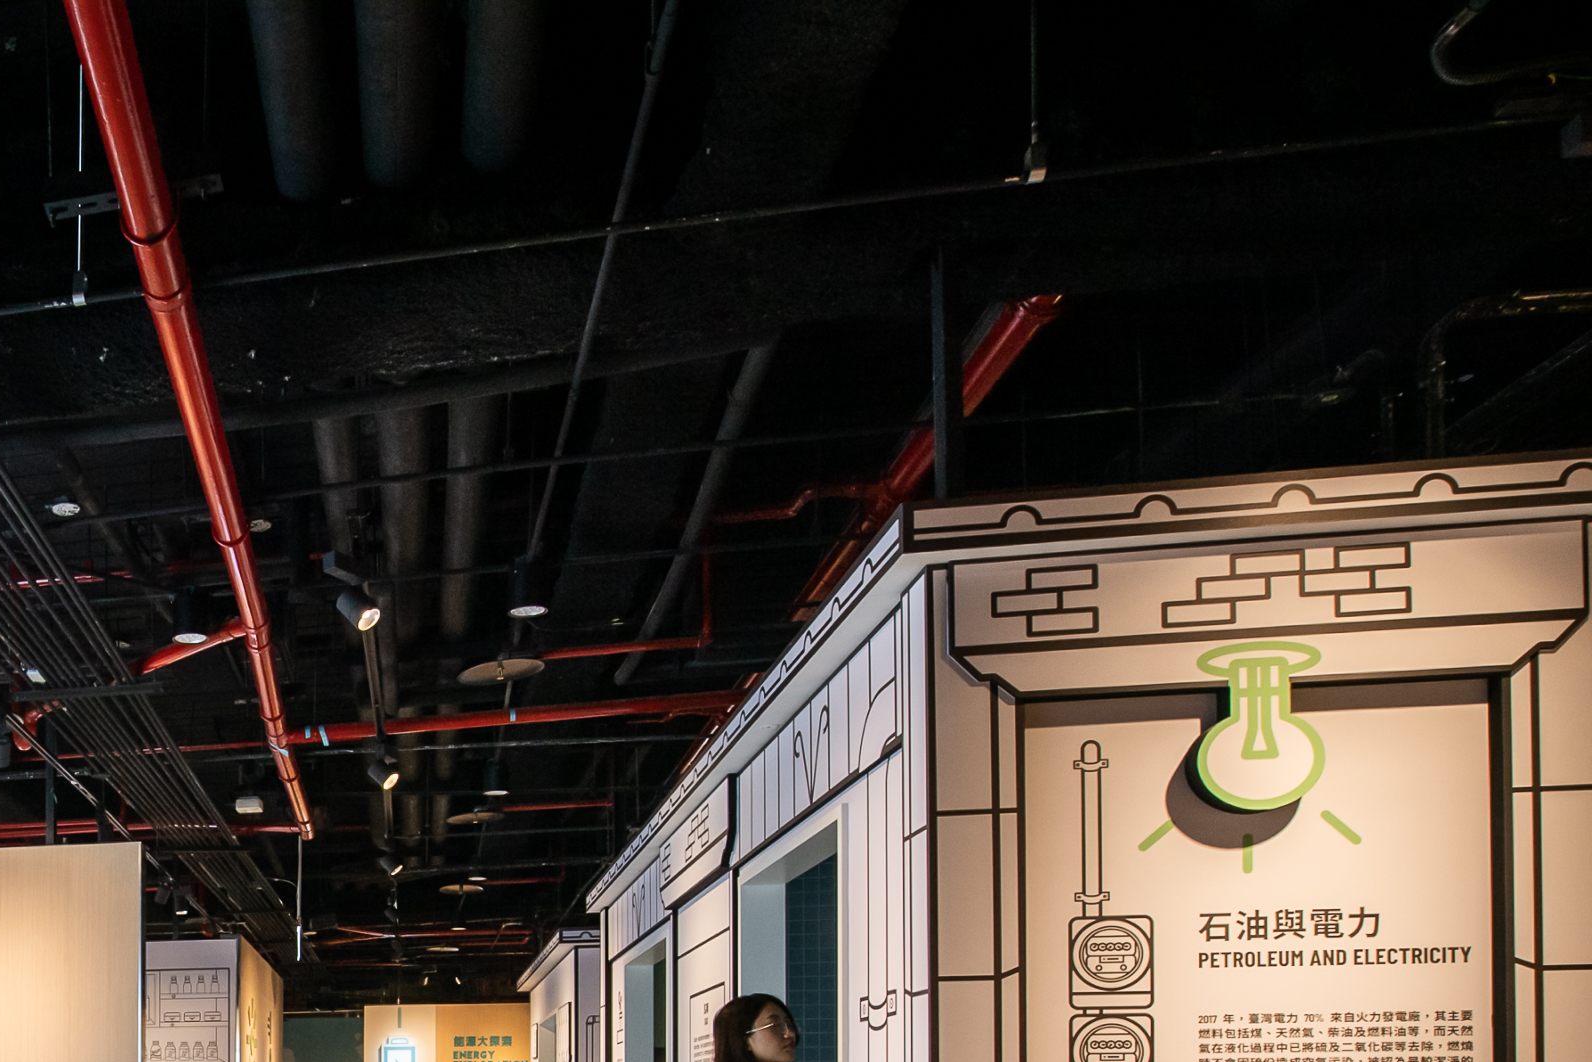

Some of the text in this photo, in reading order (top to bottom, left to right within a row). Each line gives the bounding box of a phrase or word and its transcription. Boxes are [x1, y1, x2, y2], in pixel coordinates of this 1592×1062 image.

[1199, 906, 1381, 943] 石油與電力
[1198, 946, 1472, 970] PETROLEUM AND ELECTRICITY
[1198, 1014, 1218, 1024] 2017
[1303, 1012, 1325, 1023] 70%
[453, 1050, 496, 1060] ENERGY
